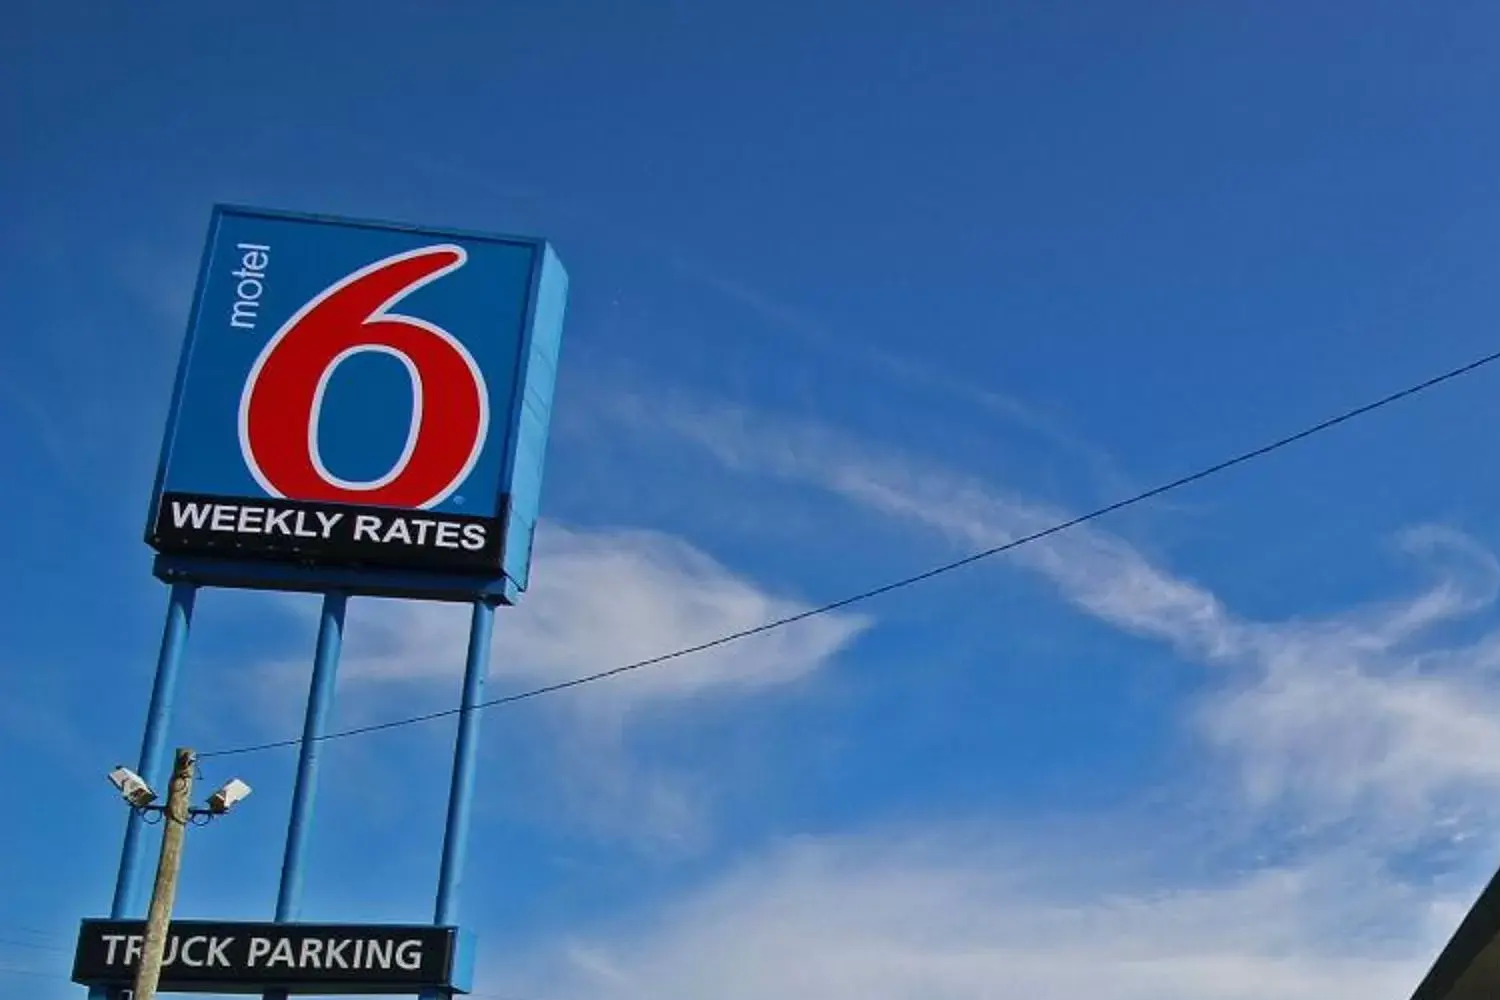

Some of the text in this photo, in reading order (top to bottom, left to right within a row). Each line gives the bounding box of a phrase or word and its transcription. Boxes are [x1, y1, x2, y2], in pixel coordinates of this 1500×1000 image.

[230, 242, 271, 329] motel
[237, 243, 490, 511] 6
[171, 500, 487, 550] WEEKLY RATES
[247, 936, 423, 970] PARKING
